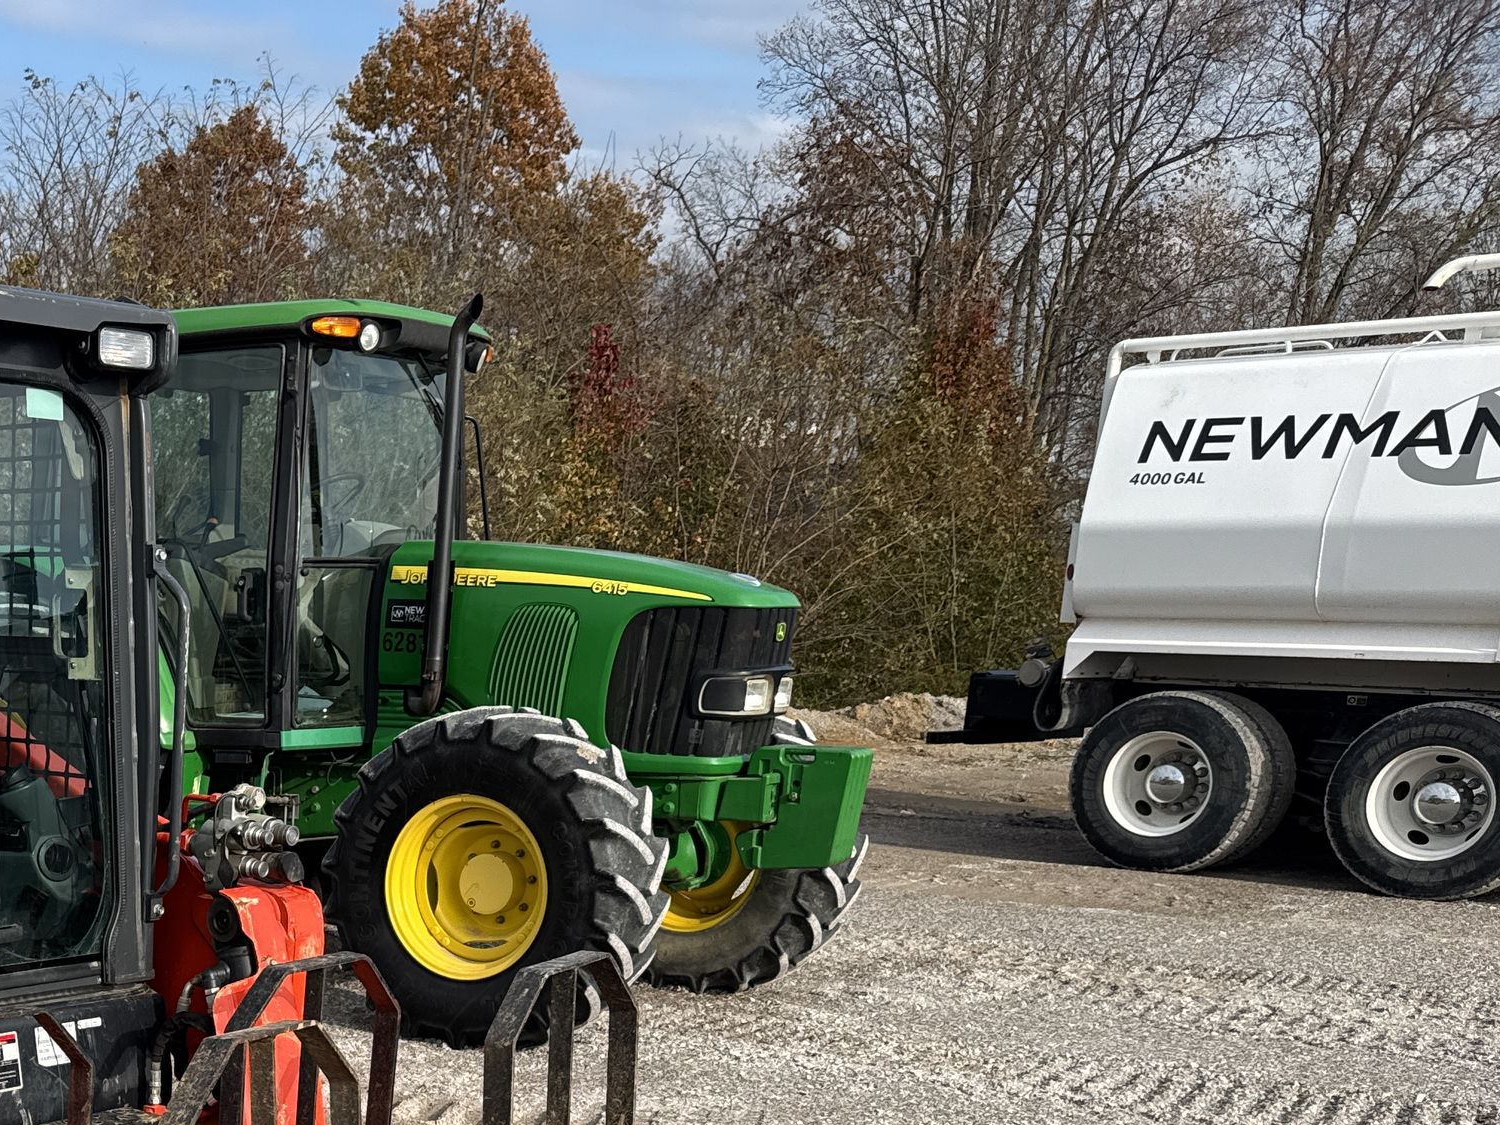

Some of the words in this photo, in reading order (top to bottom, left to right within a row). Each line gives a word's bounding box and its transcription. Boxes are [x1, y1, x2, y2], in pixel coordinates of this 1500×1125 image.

[1137, 407, 1500, 464] NEWMAN
[1129, 472, 1171, 486] 4000
[1173, 471, 1206, 485] GAL
[453, 573, 497, 587] EERE
[592, 581, 628, 596] 6415
[405, 606, 425, 615] NEW
[382, 632, 423, 653] 628
